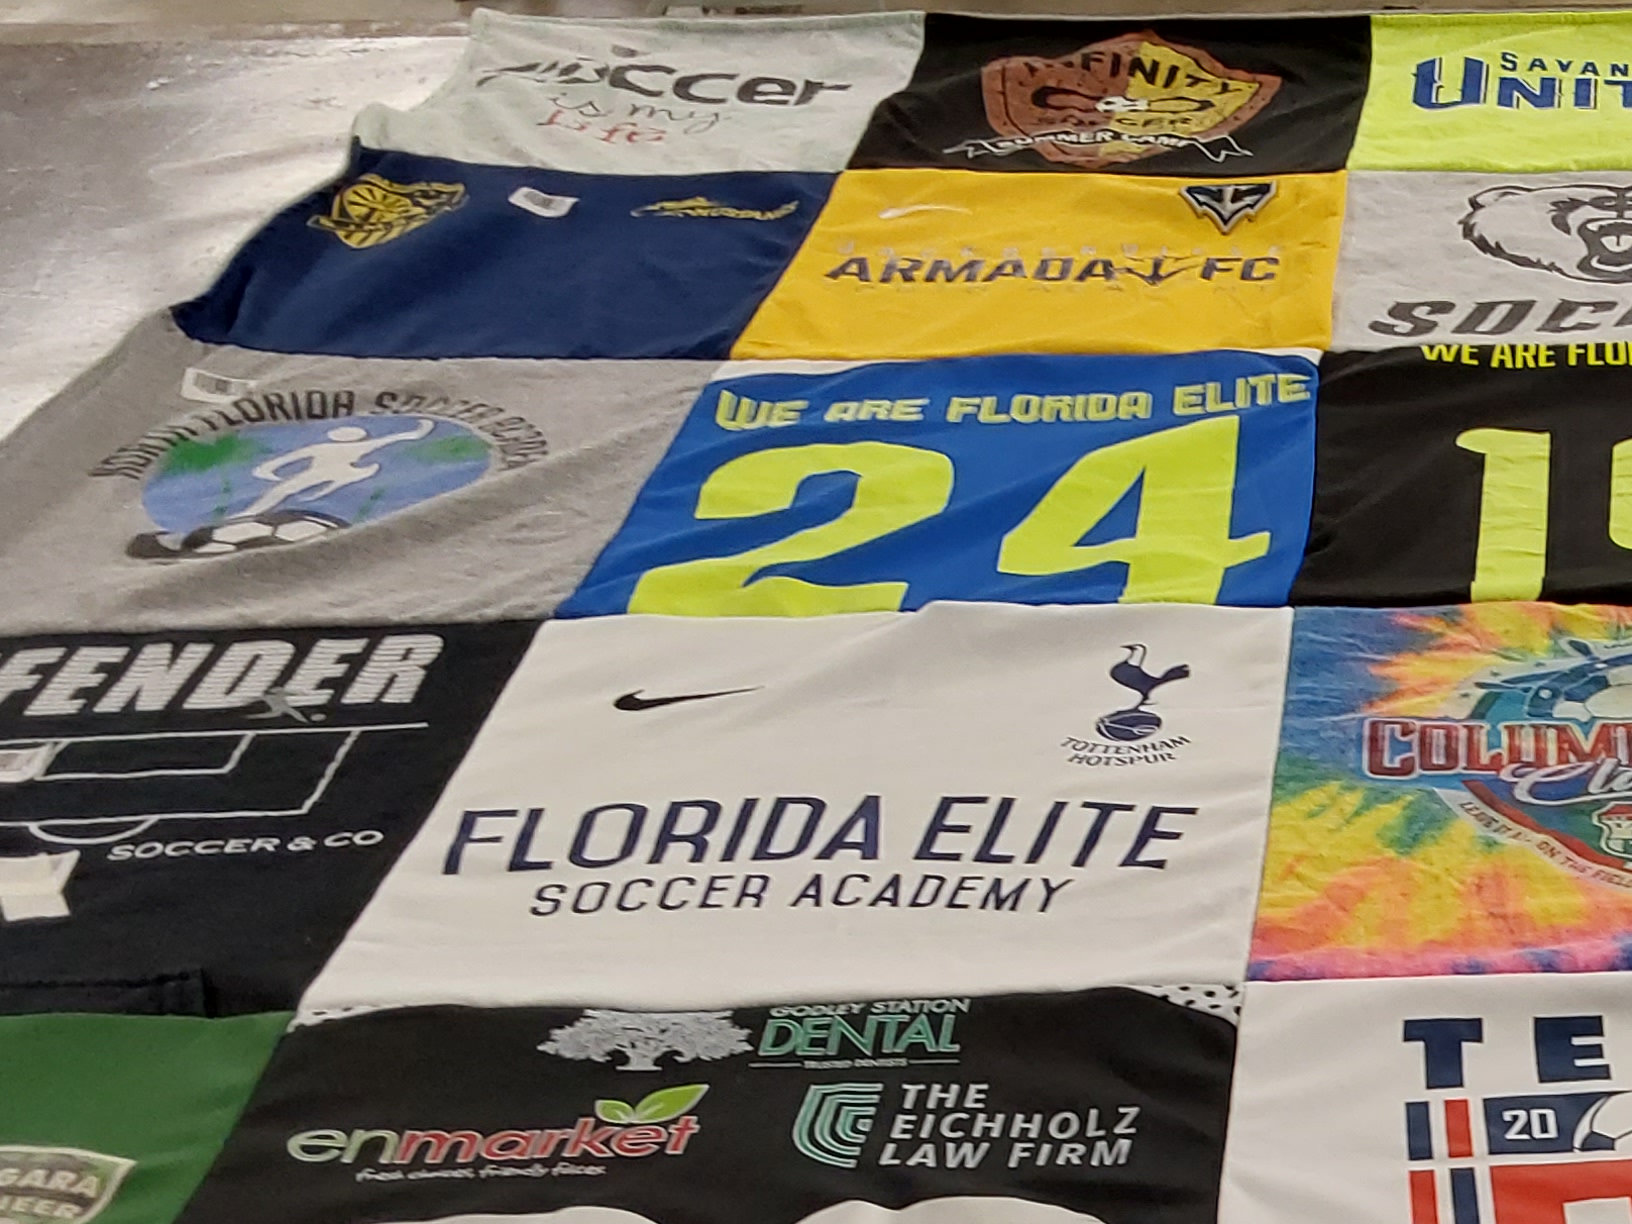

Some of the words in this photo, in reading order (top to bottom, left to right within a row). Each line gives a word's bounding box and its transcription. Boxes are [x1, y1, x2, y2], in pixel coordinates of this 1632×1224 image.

[1024, 51, 1243, 94] AFINITY
[824, 256, 1117, 283] ARMADA
[1199, 256, 1280, 281] FC
[1421, 343, 1480, 366] WE
[1490, 342, 1556, 368] ARE
[714, 390, 808, 430] WE
[825, 397, 929, 423] ARE
[946, 391, 1151, 425] FLORIDA
[1173, 373, 1312, 415] ELITE
[627, 416, 1270, 617] 24
[1061, 736, 1191, 755] TOTTENHAM
[1067, 752, 1177, 767] HOTSPUR
[107, 836, 280, 861] SOCCER
[287, 835, 316, 850] &
[323, 830, 384, 848] CO
[442, 795, 881, 875] FLORIDA
[914, 796, 1198, 870] ELITE
[1536, 840, 1562, 858] ON
[530, 873, 771, 917] SOCCER
[790, 873, 1075, 913] ACADEMY
[770, 1003, 866, 1017] GODLEY
[870, 998, 971, 1014] STATION
[757, 1014, 961, 1057] DENTAL
[902, 1083, 990, 1109] THE
[287, 1112, 700, 1164] enmarket
[889, 1106, 1141, 1139] EICHHOLZ
[1502, 1108, 1557, 1140] 20
[878, 1142, 991, 1168] LAW
[1007, 1138, 1133, 1168] FIRM
